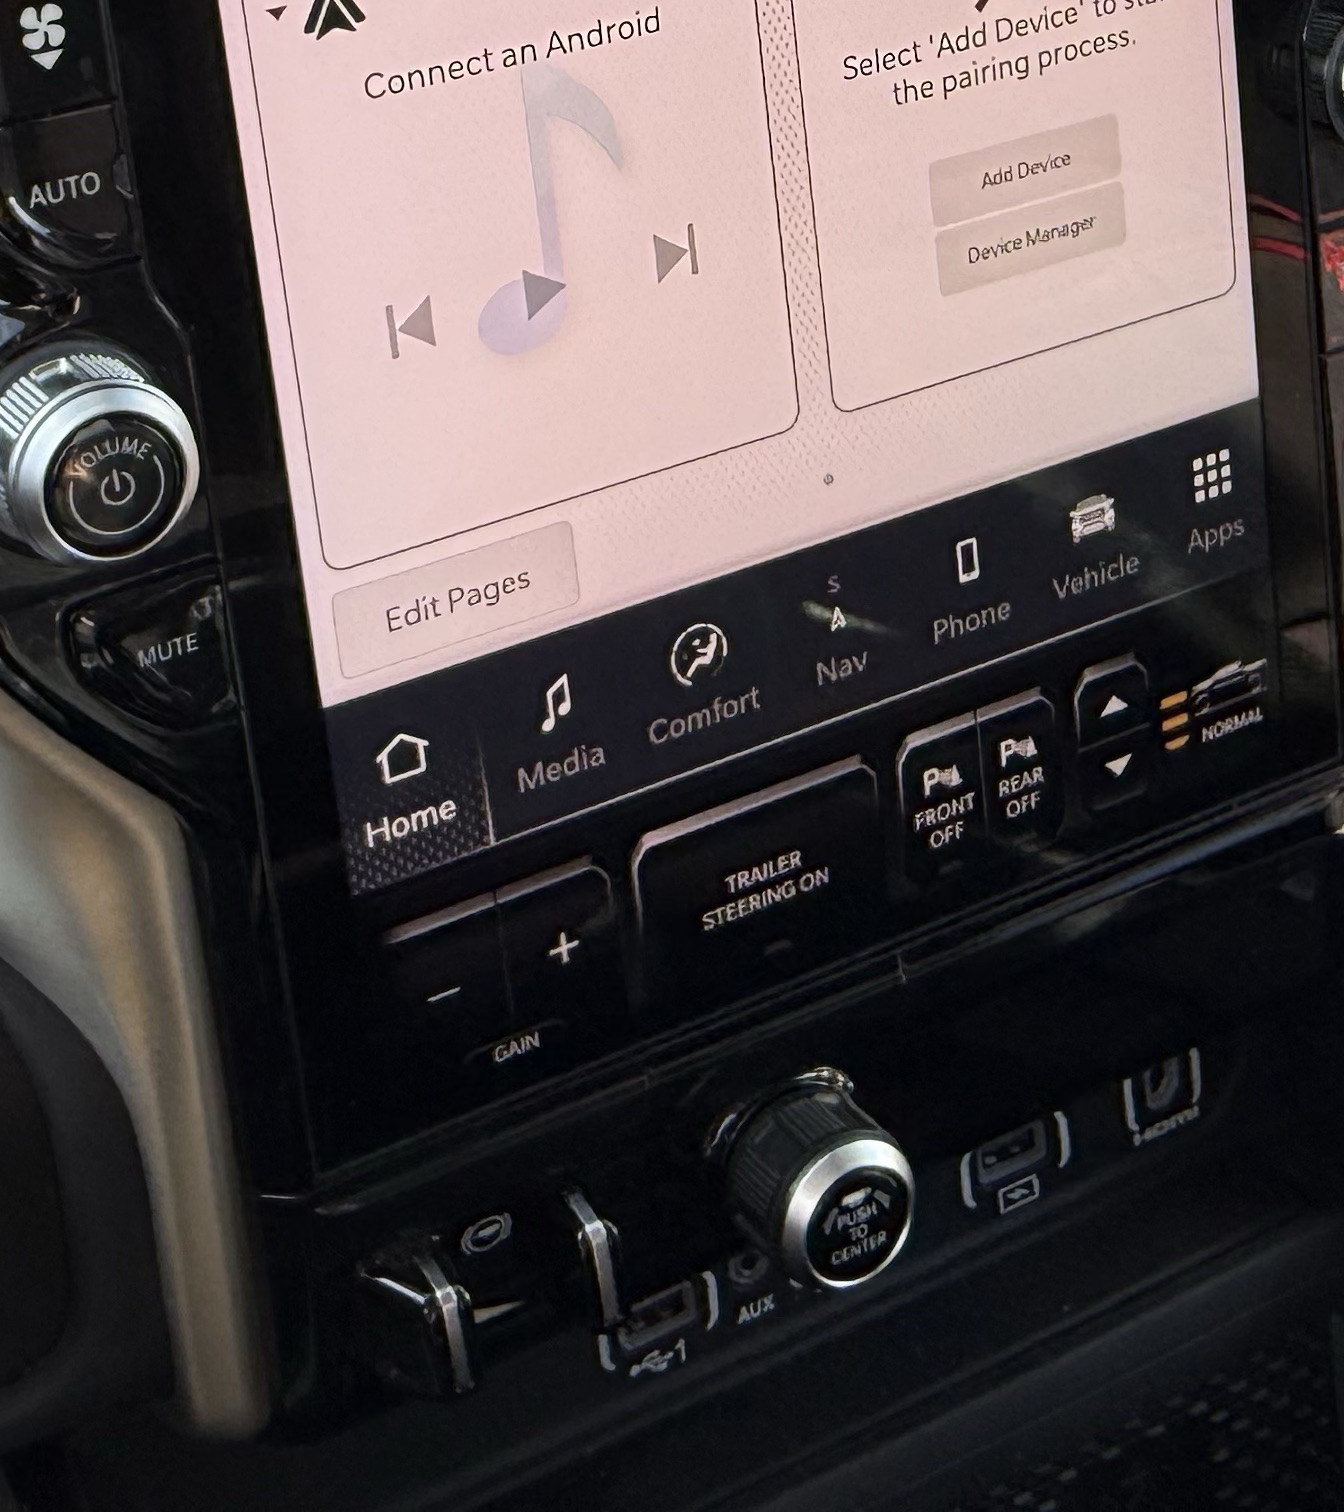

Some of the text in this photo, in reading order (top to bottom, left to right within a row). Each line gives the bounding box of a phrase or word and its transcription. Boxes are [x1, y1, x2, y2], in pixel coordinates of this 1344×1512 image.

[363, 5, 662, 100] Connect an Android
[842, 40, 923, 81] Select
[929, 21, 987, 59] 'Add
[892, 29, 1138, 106] the pairing process.
[27, 169, 102, 210] AUTO
[981, 152, 1072, 190] Add Device
[967, 215, 1097, 264] Device Manager
[68, 436, 152, 478] VOLUME
[1186, 517, 1246, 556] Apps
[1051, 552, 1142, 601] Vehicle
[384, 569, 532, 634] Edit Pages
[931, 598, 1013, 646] Phone
[137, 632, 200, 669] MUTE
[814, 649, 869, 687] Nav
[645, 685, 762, 746] Comfort
[1201, 706, 1264, 744] NORMAL
[515, 743, 607, 794] Media
[998, 766, 1045, 798] REAR
[365, 797, 458, 848] Home
[913, 791, 976, 833] FRONT
[1005, 790, 1041, 819] OFF
[929, 820, 965, 849] OFF
[723, 849, 802, 894] TRAILER
[701, 866, 830, 931] STEERING ON
[490, 1031, 541, 1063] GAIN
[736, 1293, 777, 1327] AUX
